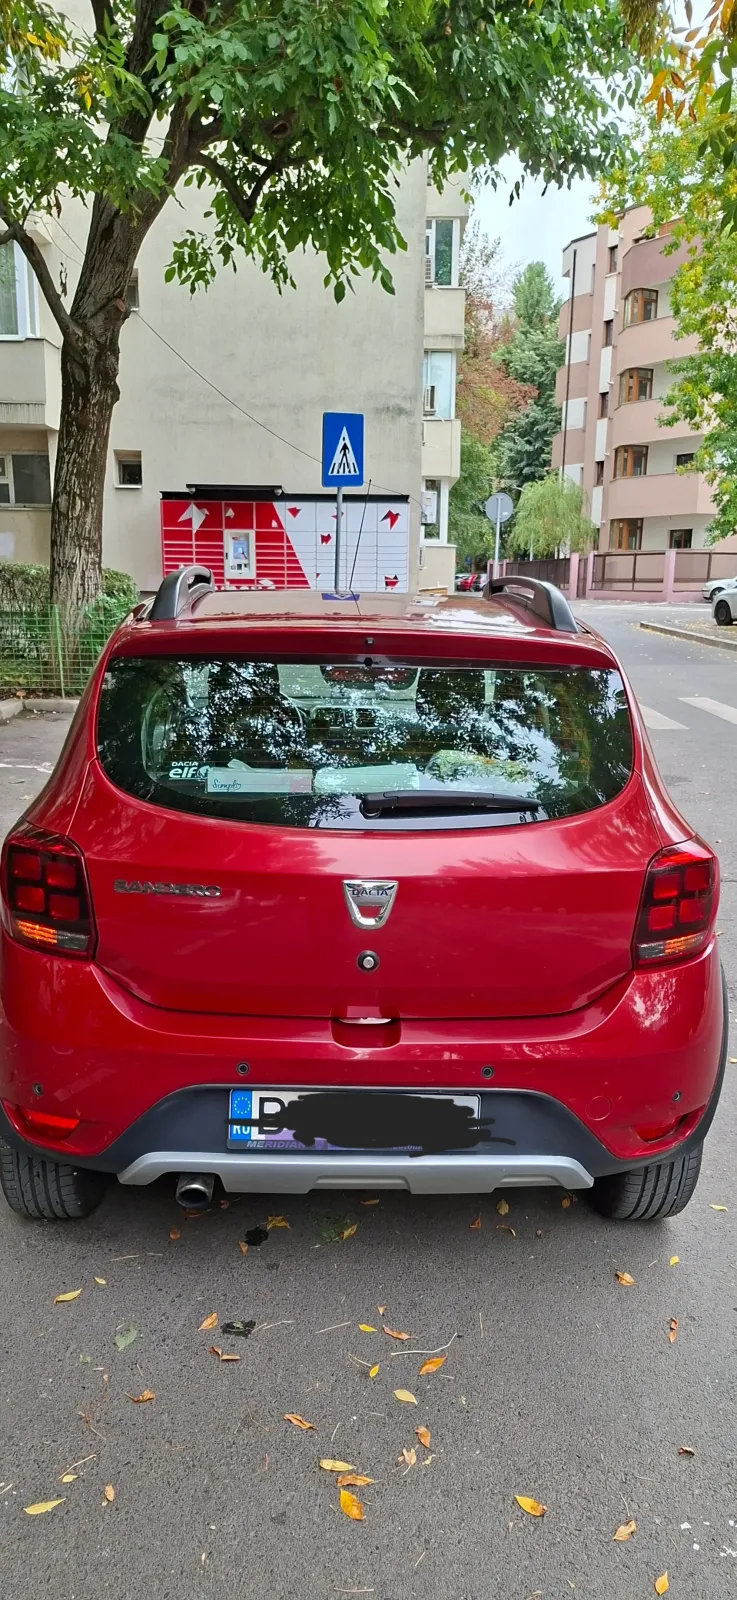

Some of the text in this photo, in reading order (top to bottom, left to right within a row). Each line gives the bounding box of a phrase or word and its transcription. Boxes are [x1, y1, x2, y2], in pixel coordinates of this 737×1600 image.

[168, 766, 197, 779] elf
[113, 879, 222, 897] SANDERO
[351, 887, 388, 897] DACIA
